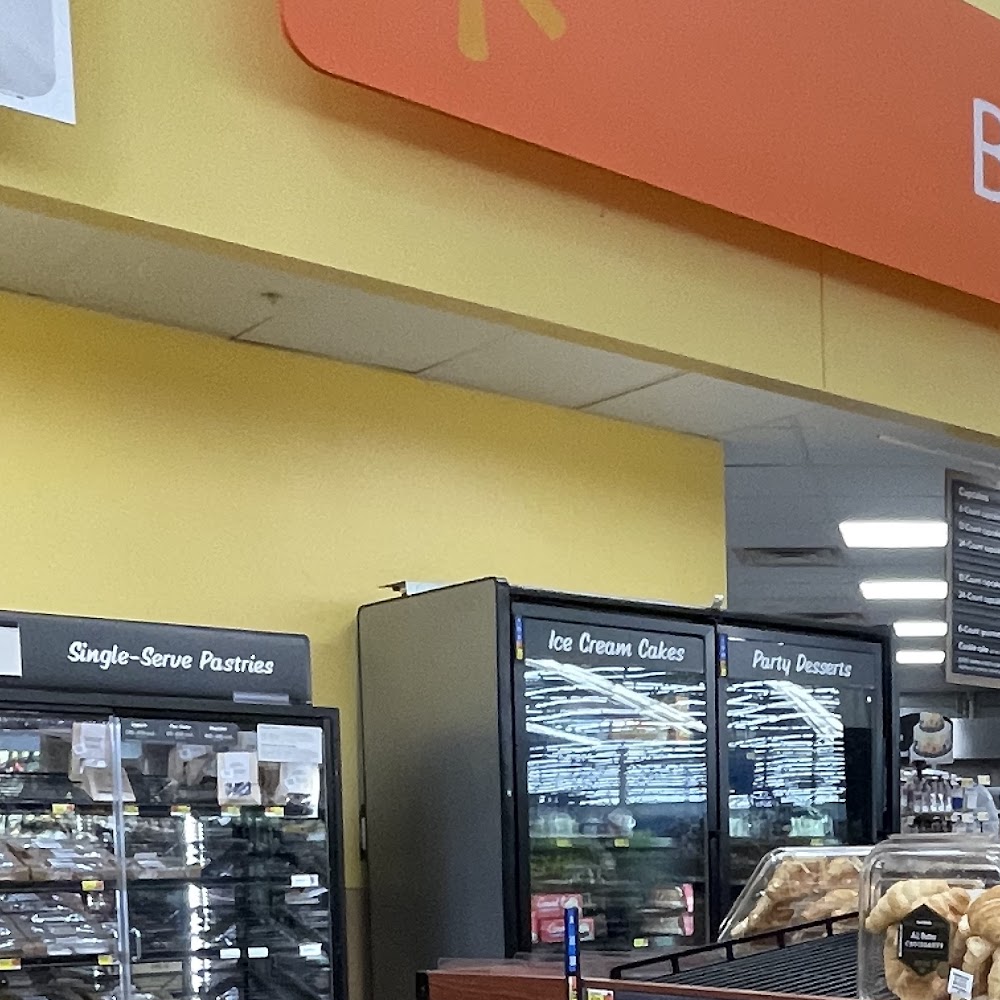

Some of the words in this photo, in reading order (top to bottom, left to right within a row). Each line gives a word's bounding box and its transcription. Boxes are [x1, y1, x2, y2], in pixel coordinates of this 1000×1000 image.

[67, 641, 194, 670] Single-Serve
[199, 650, 274, 675] Pastries
[548, 629, 573, 652] Ice
[579, 632, 633, 657] Cream
[637, 638, 685, 662] Cakes
[752, 649, 791, 675] Party
[796, 654, 852, 677] Desserts
